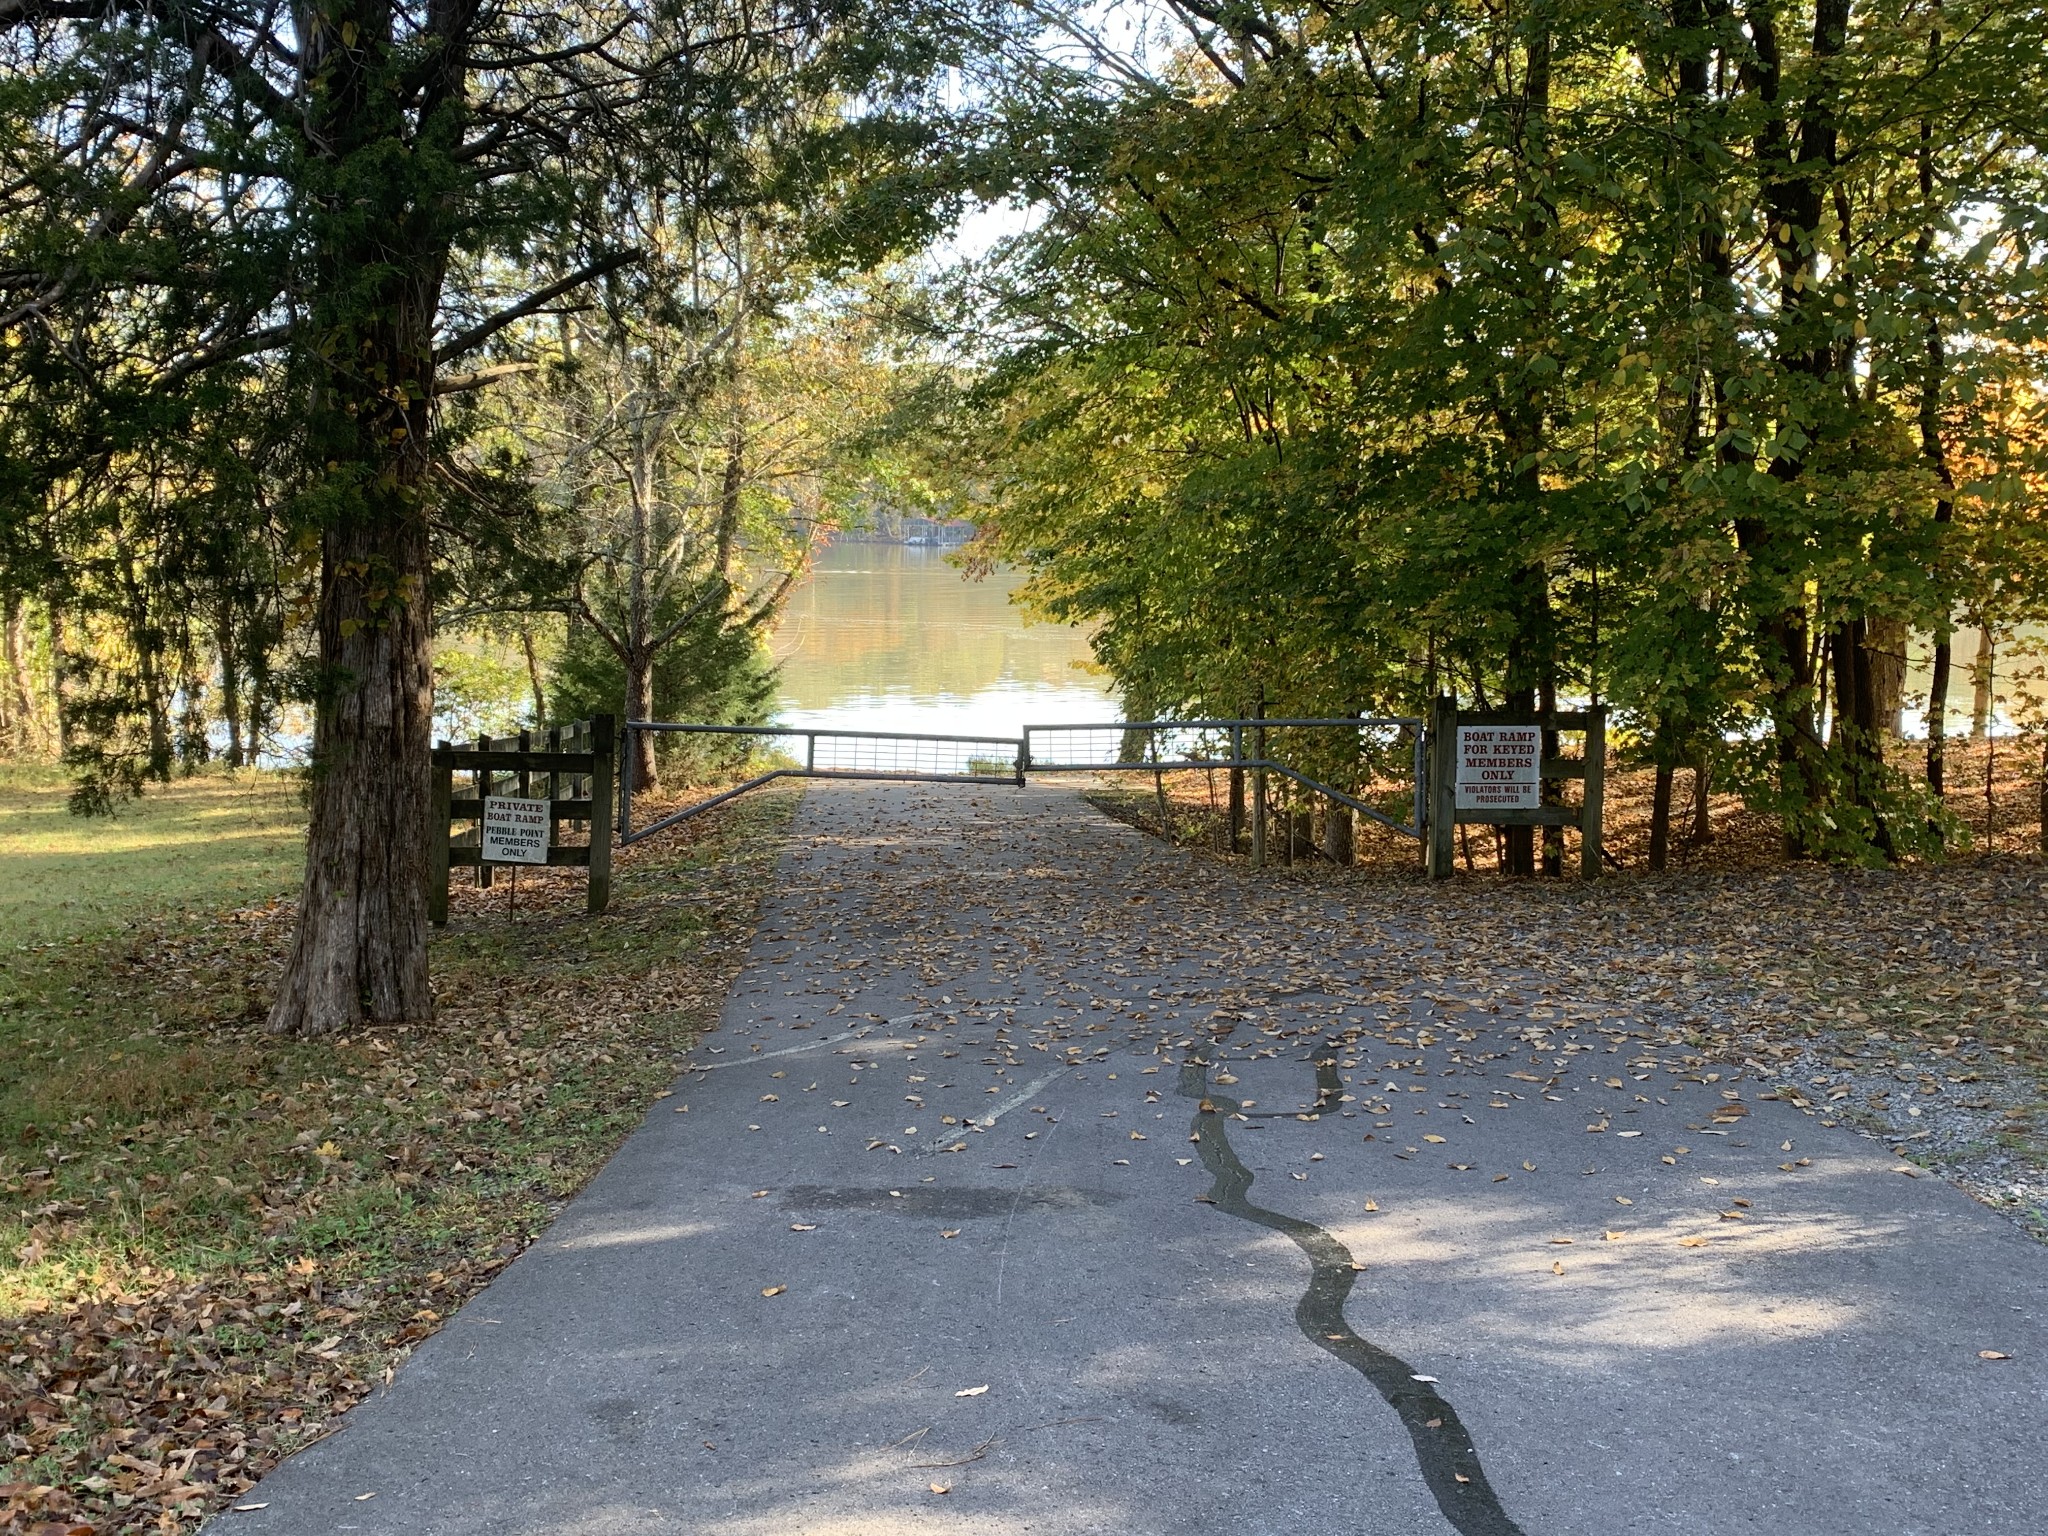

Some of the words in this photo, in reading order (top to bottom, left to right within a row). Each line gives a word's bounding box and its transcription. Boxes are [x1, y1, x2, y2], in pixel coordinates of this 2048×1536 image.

[1463, 732, 1494, 742] BOAT
[1499, 732, 1536, 742] RAMP
[1463, 745, 1488, 754] FOR
[1493, 745, 1535, 754] KEYED
[1465, 758, 1532, 768] MEMBERS
[1481, 770, 1515, 780] ONLY
[1464, 786, 1502, 794] VIOLATORS
[1504, 786, 1520, 794] WILL
[1522, 786, 1532, 794] BE
[1476, 795, 1520, 803] PROSECUTED
[489, 801, 544, 813] PRIVATE
[486, 812, 512, 822] BOAT
[514, 814, 544, 824] RAMP
[486, 826, 517, 836] PEBBLE
[520, 828, 545, 838] POINT
[490, 836, 540, 848] MEMBERS
[501, 847, 528, 857] ONLY
